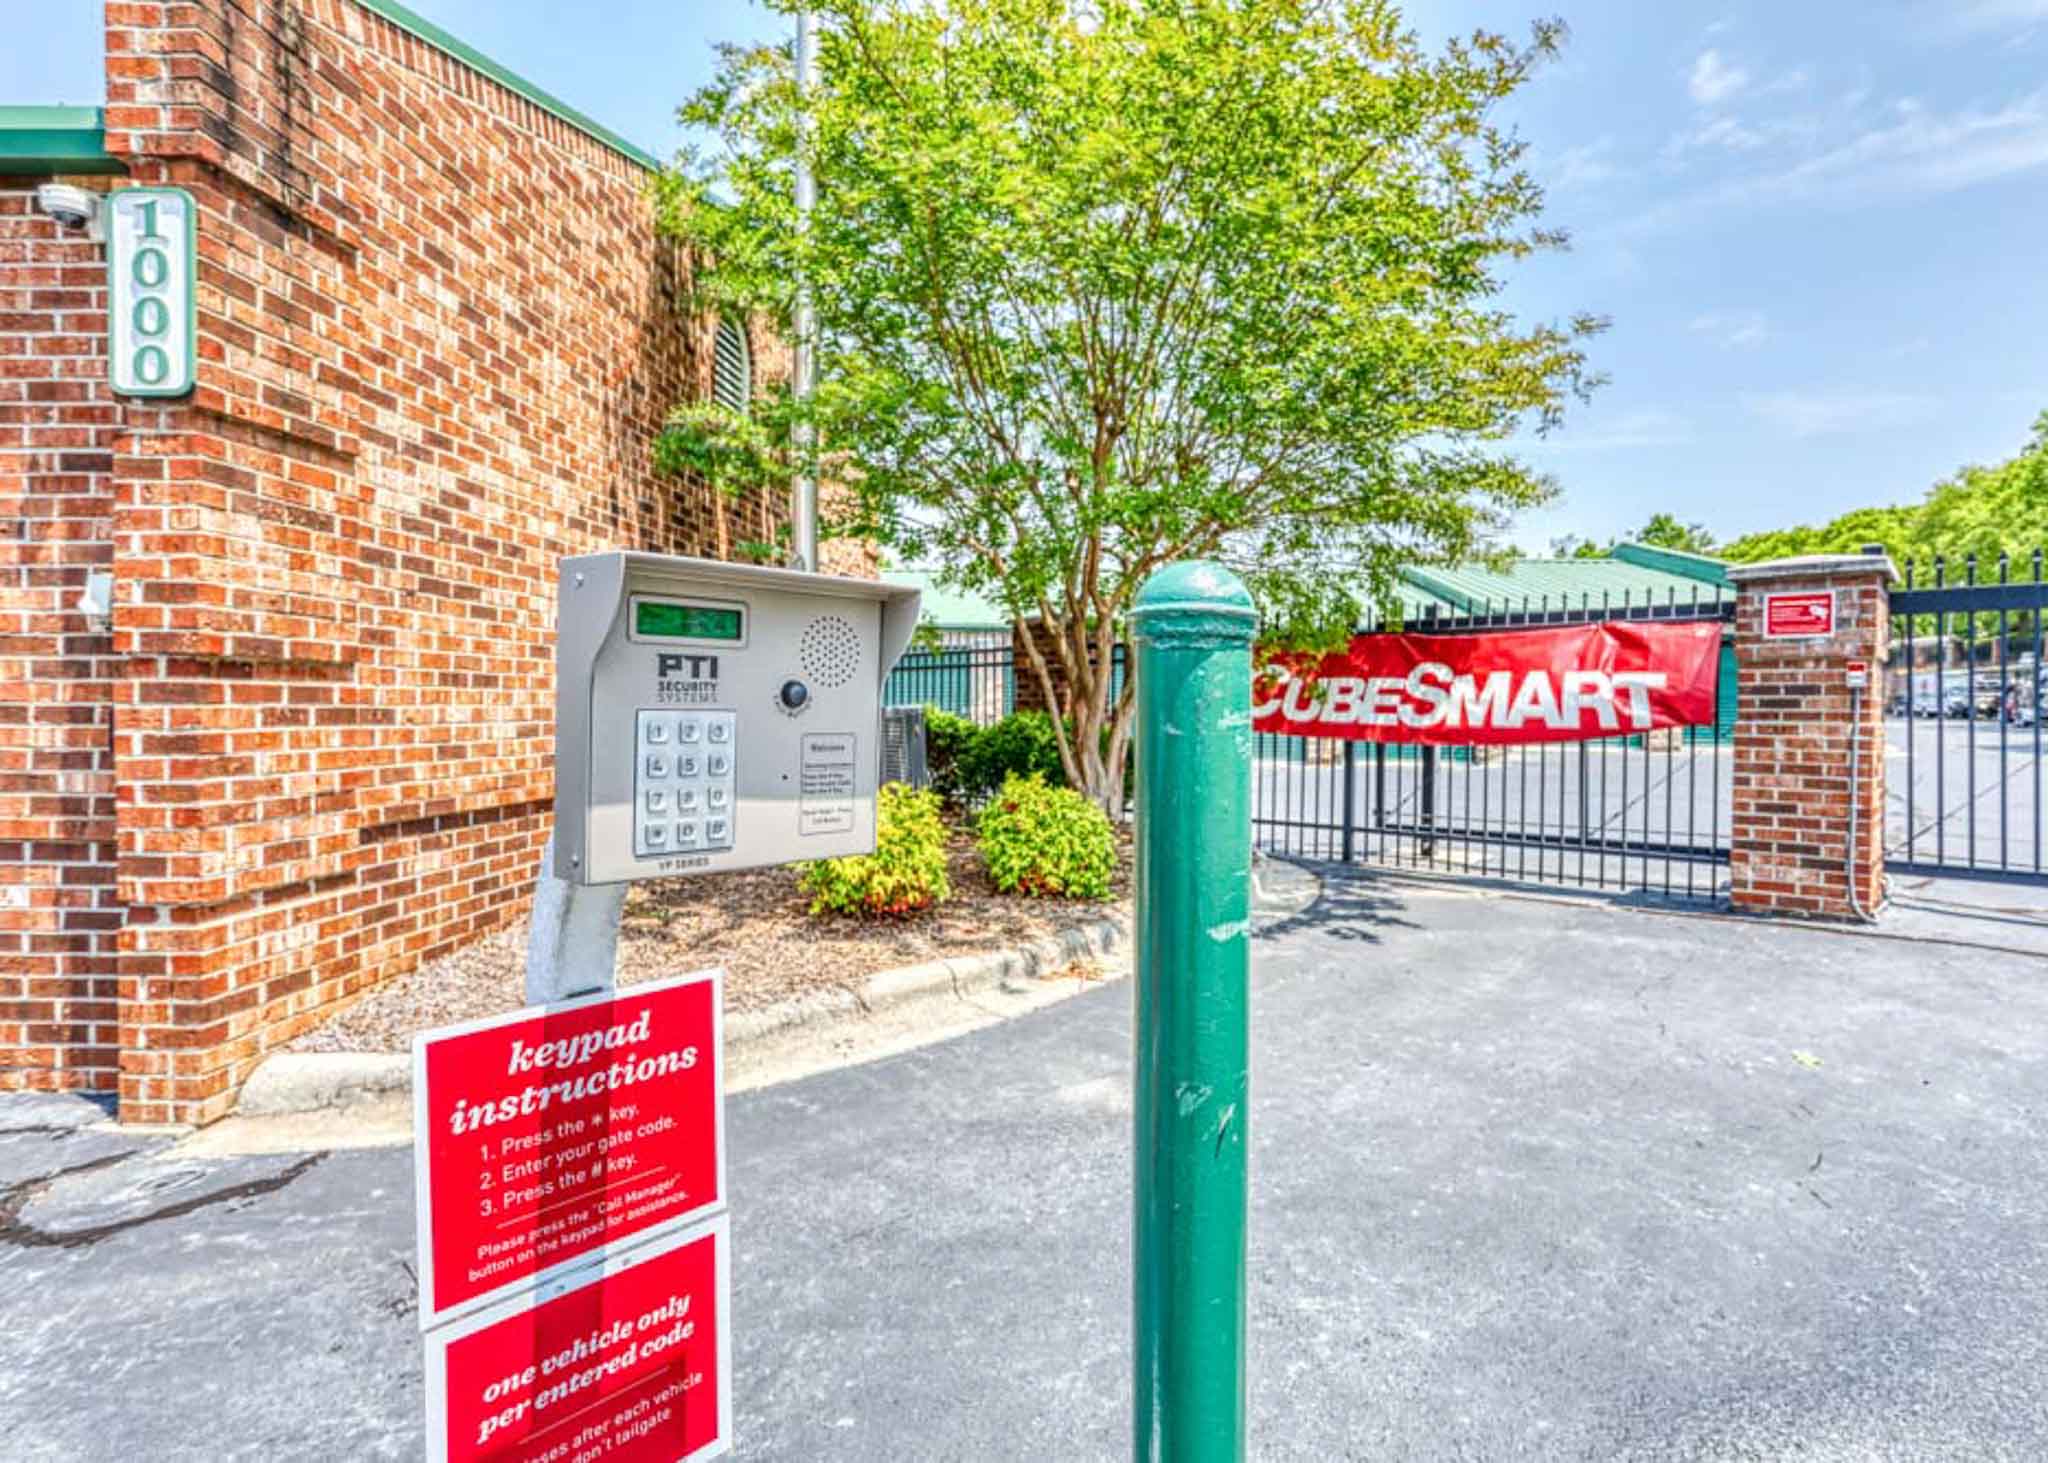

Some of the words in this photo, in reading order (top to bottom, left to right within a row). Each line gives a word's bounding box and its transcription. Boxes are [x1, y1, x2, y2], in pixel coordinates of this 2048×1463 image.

[131, 200, 170, 385] 1000
[658, 654, 718, 679] PTI
[658, 681, 717, 692] SECURITY
[658, 692, 718, 703] SYSTEMS
[655, 724, 662, 737] 1
[685, 758, 695, 772] 5
[508, 1009, 651, 1076] keypad
[449, 1046, 698, 1136] instructions
[480, 1145, 496, 1161] 1.
[502, 1129, 553, 1155] Press
[557, 1118, 585, 1138] the
[609, 1103, 640, 1123] key.
[480, 1172, 496, 1190] 2.
[503, 1155, 553, 1183] Enter
[556, 1142, 593, 1168] your
[598, 1129, 633, 1154] gate
[637, 1116, 678, 1138] code.
[480, 1200, 498, 1217] 3.
[503, 1182, 554, 1209] Press
[558, 1170, 586, 1189] the
[607, 1153, 637, 1175] key.
[468, 1256, 514, 1282] button
[517, 1248, 536, 1263] on
[537, 1237, 558, 1254] the
[560, 1218, 605, 1247] keypad
[607, 1212, 625, 1229] for
[627, 1191, 688, 1220] assistance.
[477, 1233, 525, 1260] Please
[528, 1218, 566, 1243] press
[568, 1210, 589, 1226] the
[483, 1364, 537, 1404] one
[541, 1320, 633, 1375] vehicle
[637, 1295, 692, 1331] only
[476, 1397, 532, 1445] per
[534, 1342, 637, 1410] entered
[640, 1320, 695, 1357] code
[571, 1421, 610, 1449] after
[613, 1401, 651, 1425] each
[652, 1371, 703, 1404] vehicle
[615, 1407, 672, 1444] tailgate
